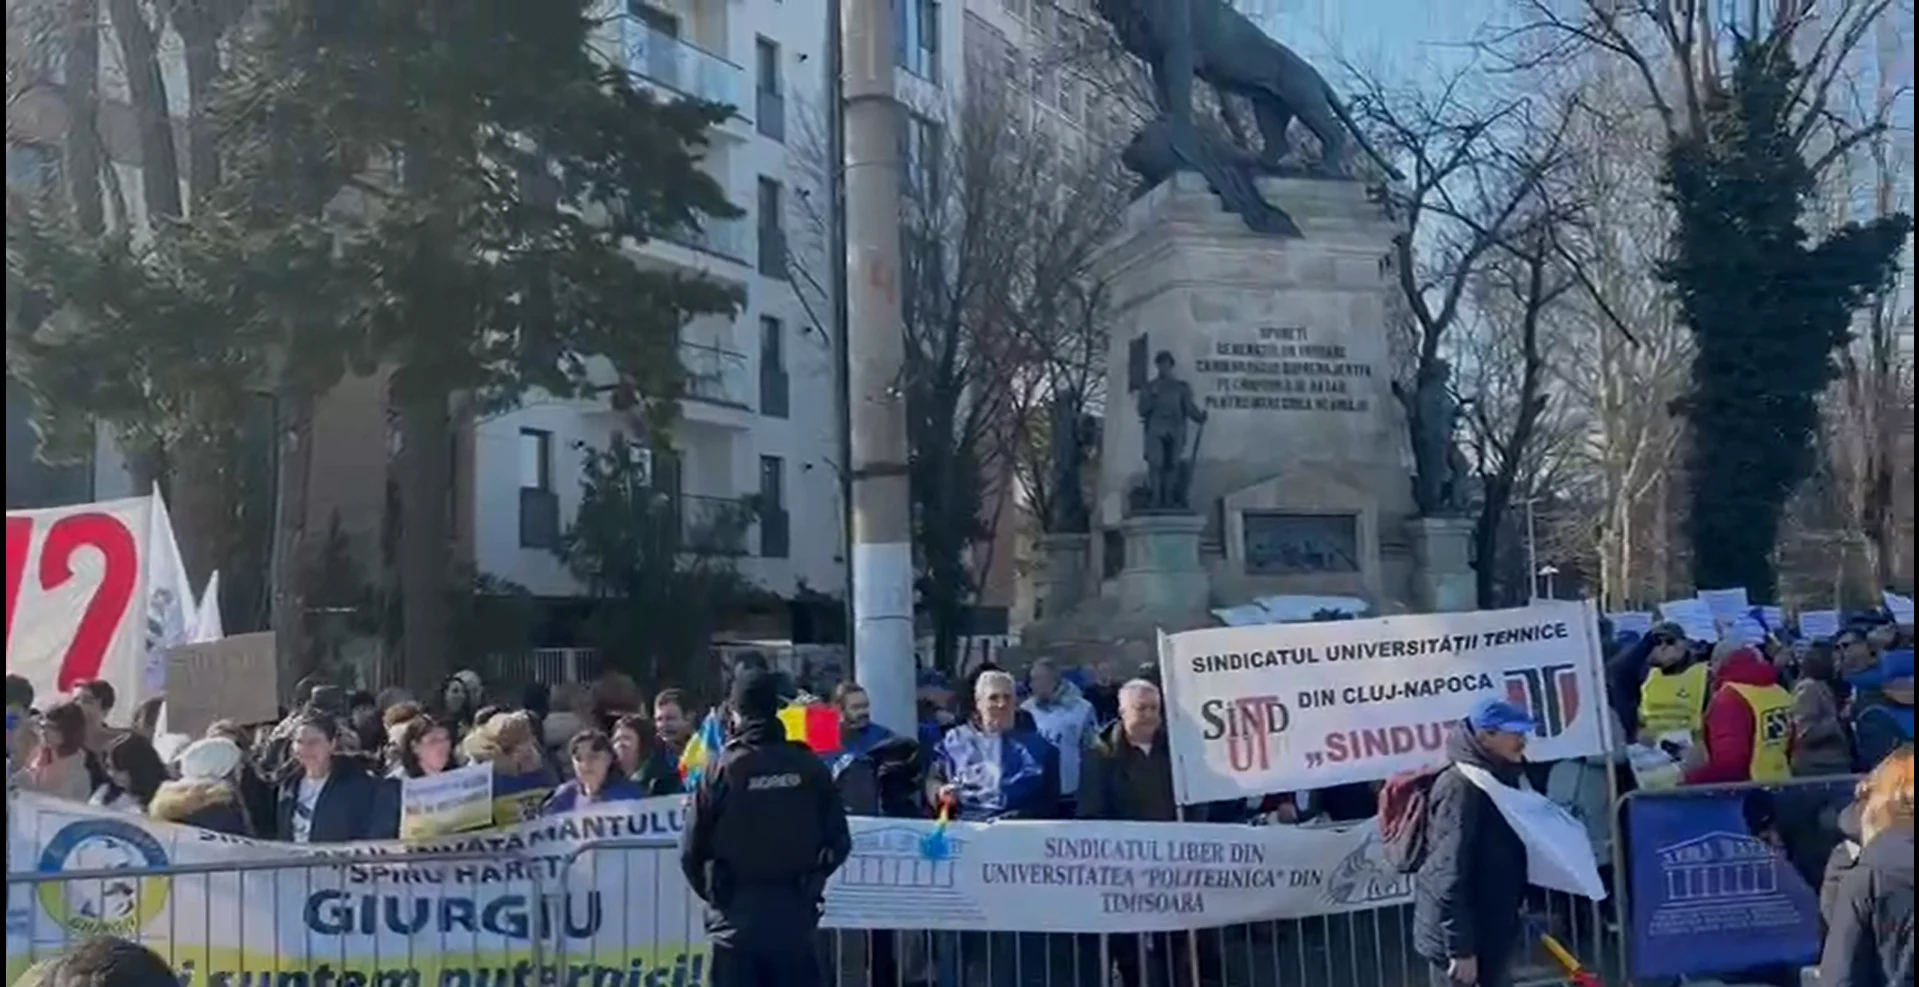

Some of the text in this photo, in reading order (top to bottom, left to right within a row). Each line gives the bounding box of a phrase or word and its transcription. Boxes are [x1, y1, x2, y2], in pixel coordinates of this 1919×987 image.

[1192, 648, 1319, 673] SINDICATUL
[1484, 622, 1568, 647] TEHNICE
[1298, 673, 1494, 708] DIN CLUJ-NAPOCA
[1045, 838, 1265, 864] SINDICATUL LIBER DIN
[982, 863, 1134, 886] UNIVERSITATEA
[1289, 869, 1322, 887] DIN
[303, 888, 602, 940] GIURGIU
[1101, 891, 1205, 914] TIMISOARA
